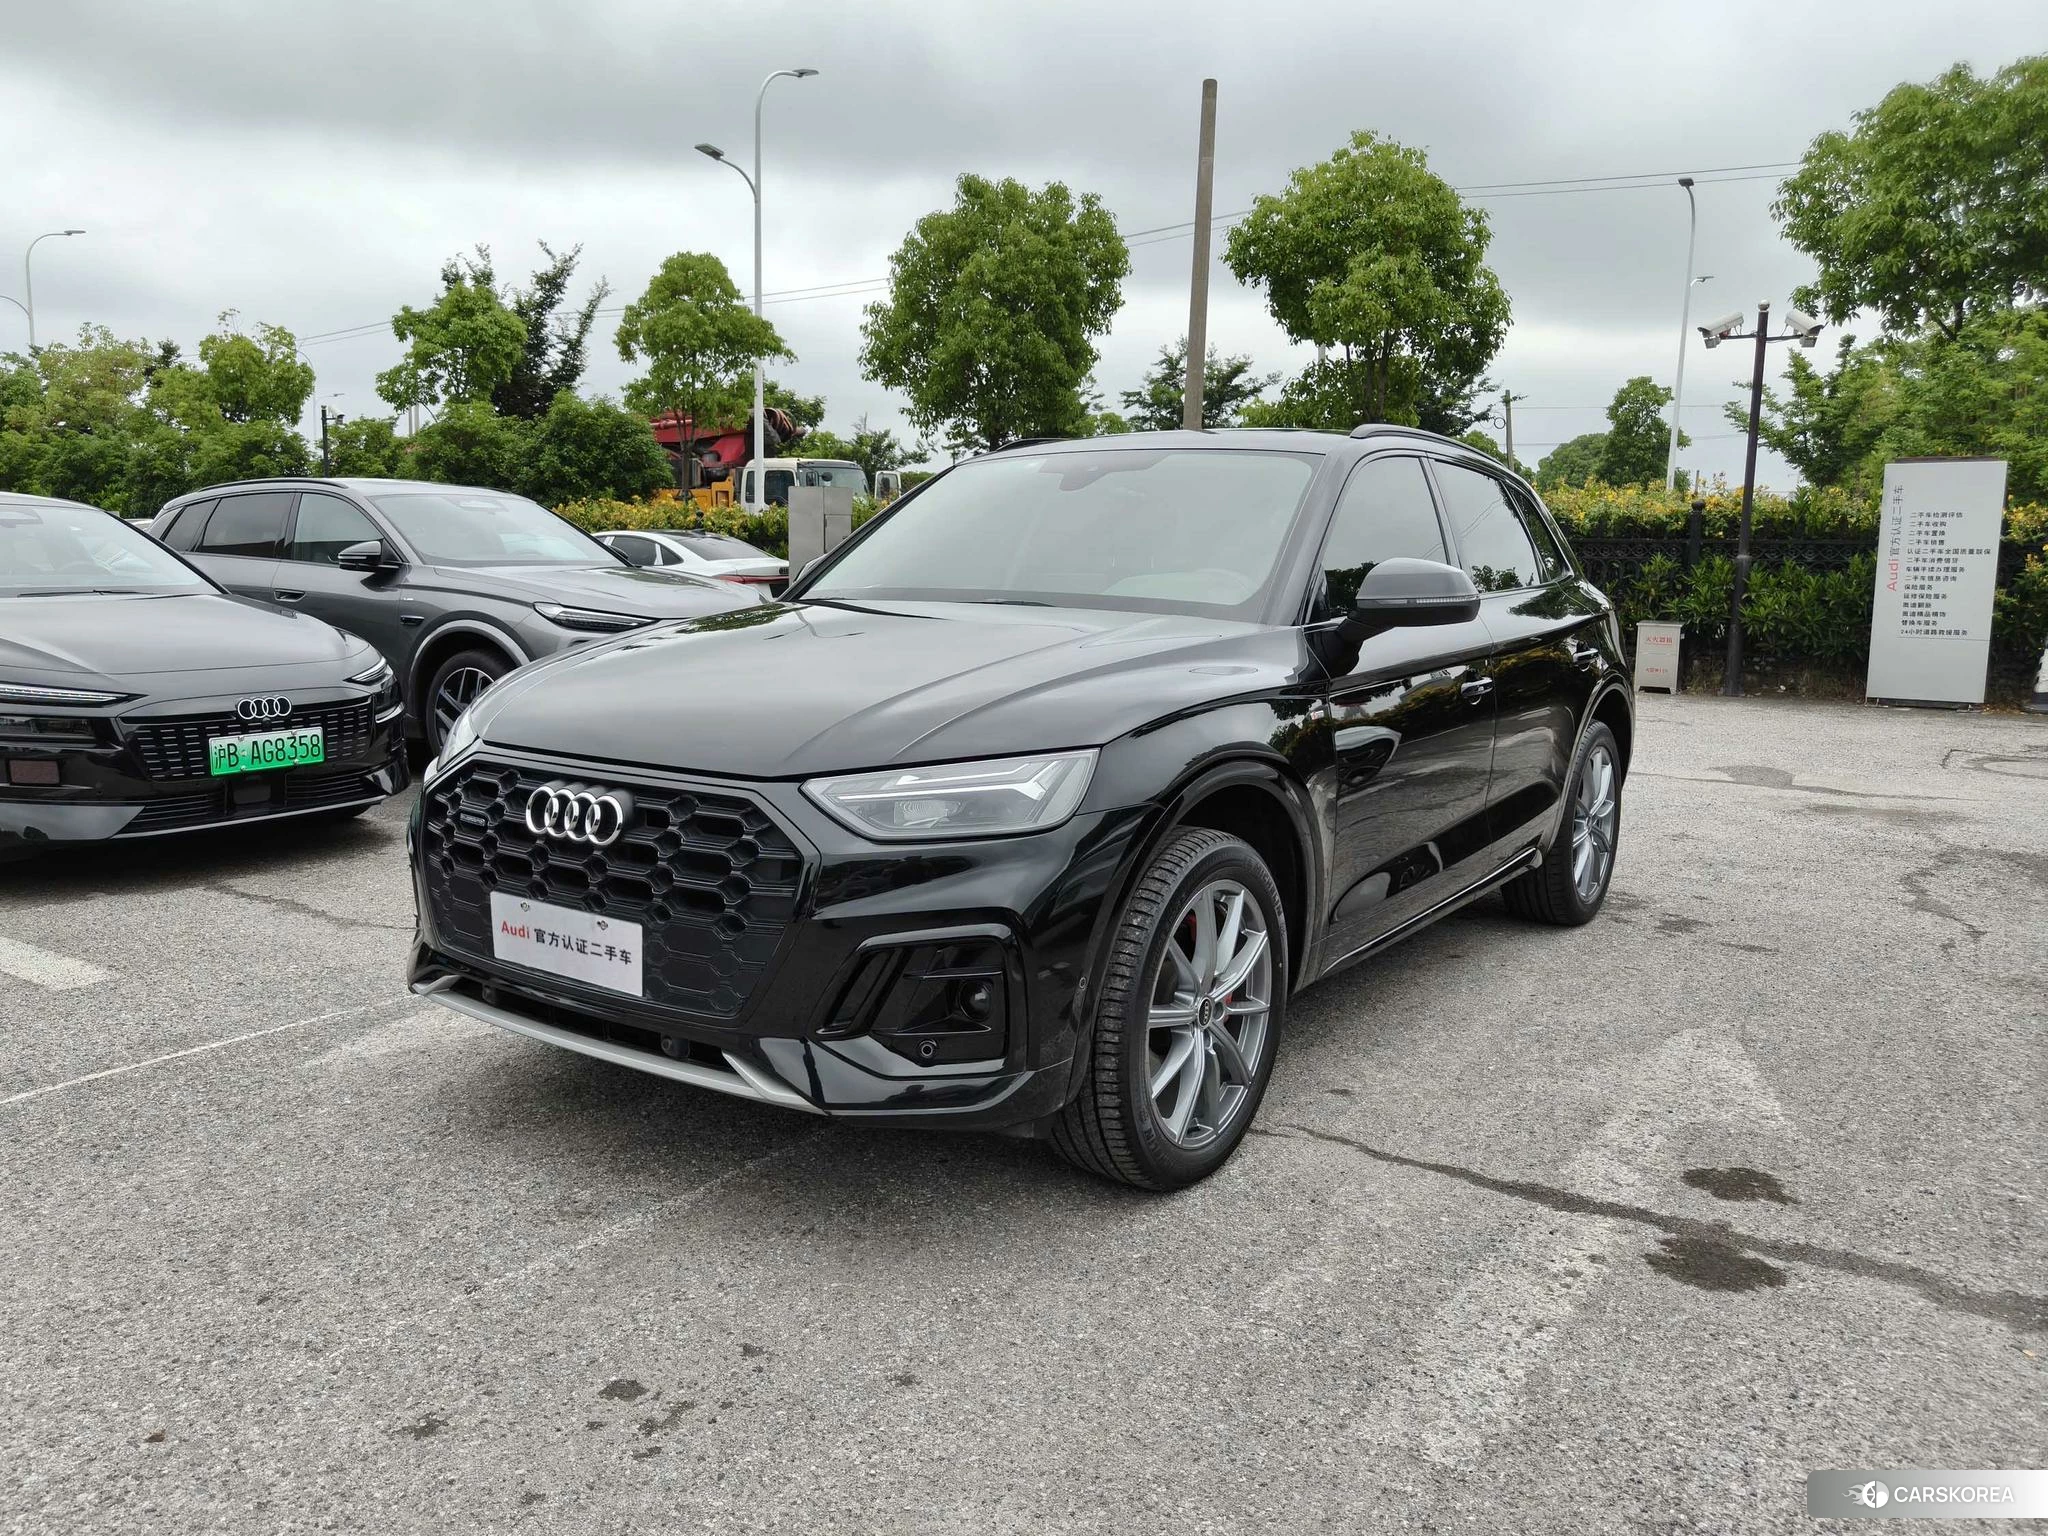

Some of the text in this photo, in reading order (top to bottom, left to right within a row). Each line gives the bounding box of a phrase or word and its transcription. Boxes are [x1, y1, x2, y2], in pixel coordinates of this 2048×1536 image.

[1887, 485, 1904, 592] Audi 官方认证二手车
[214, 734, 321, 769] 沪B AG8358
[501, 920, 632, 965] Audi 官方认证二手车
